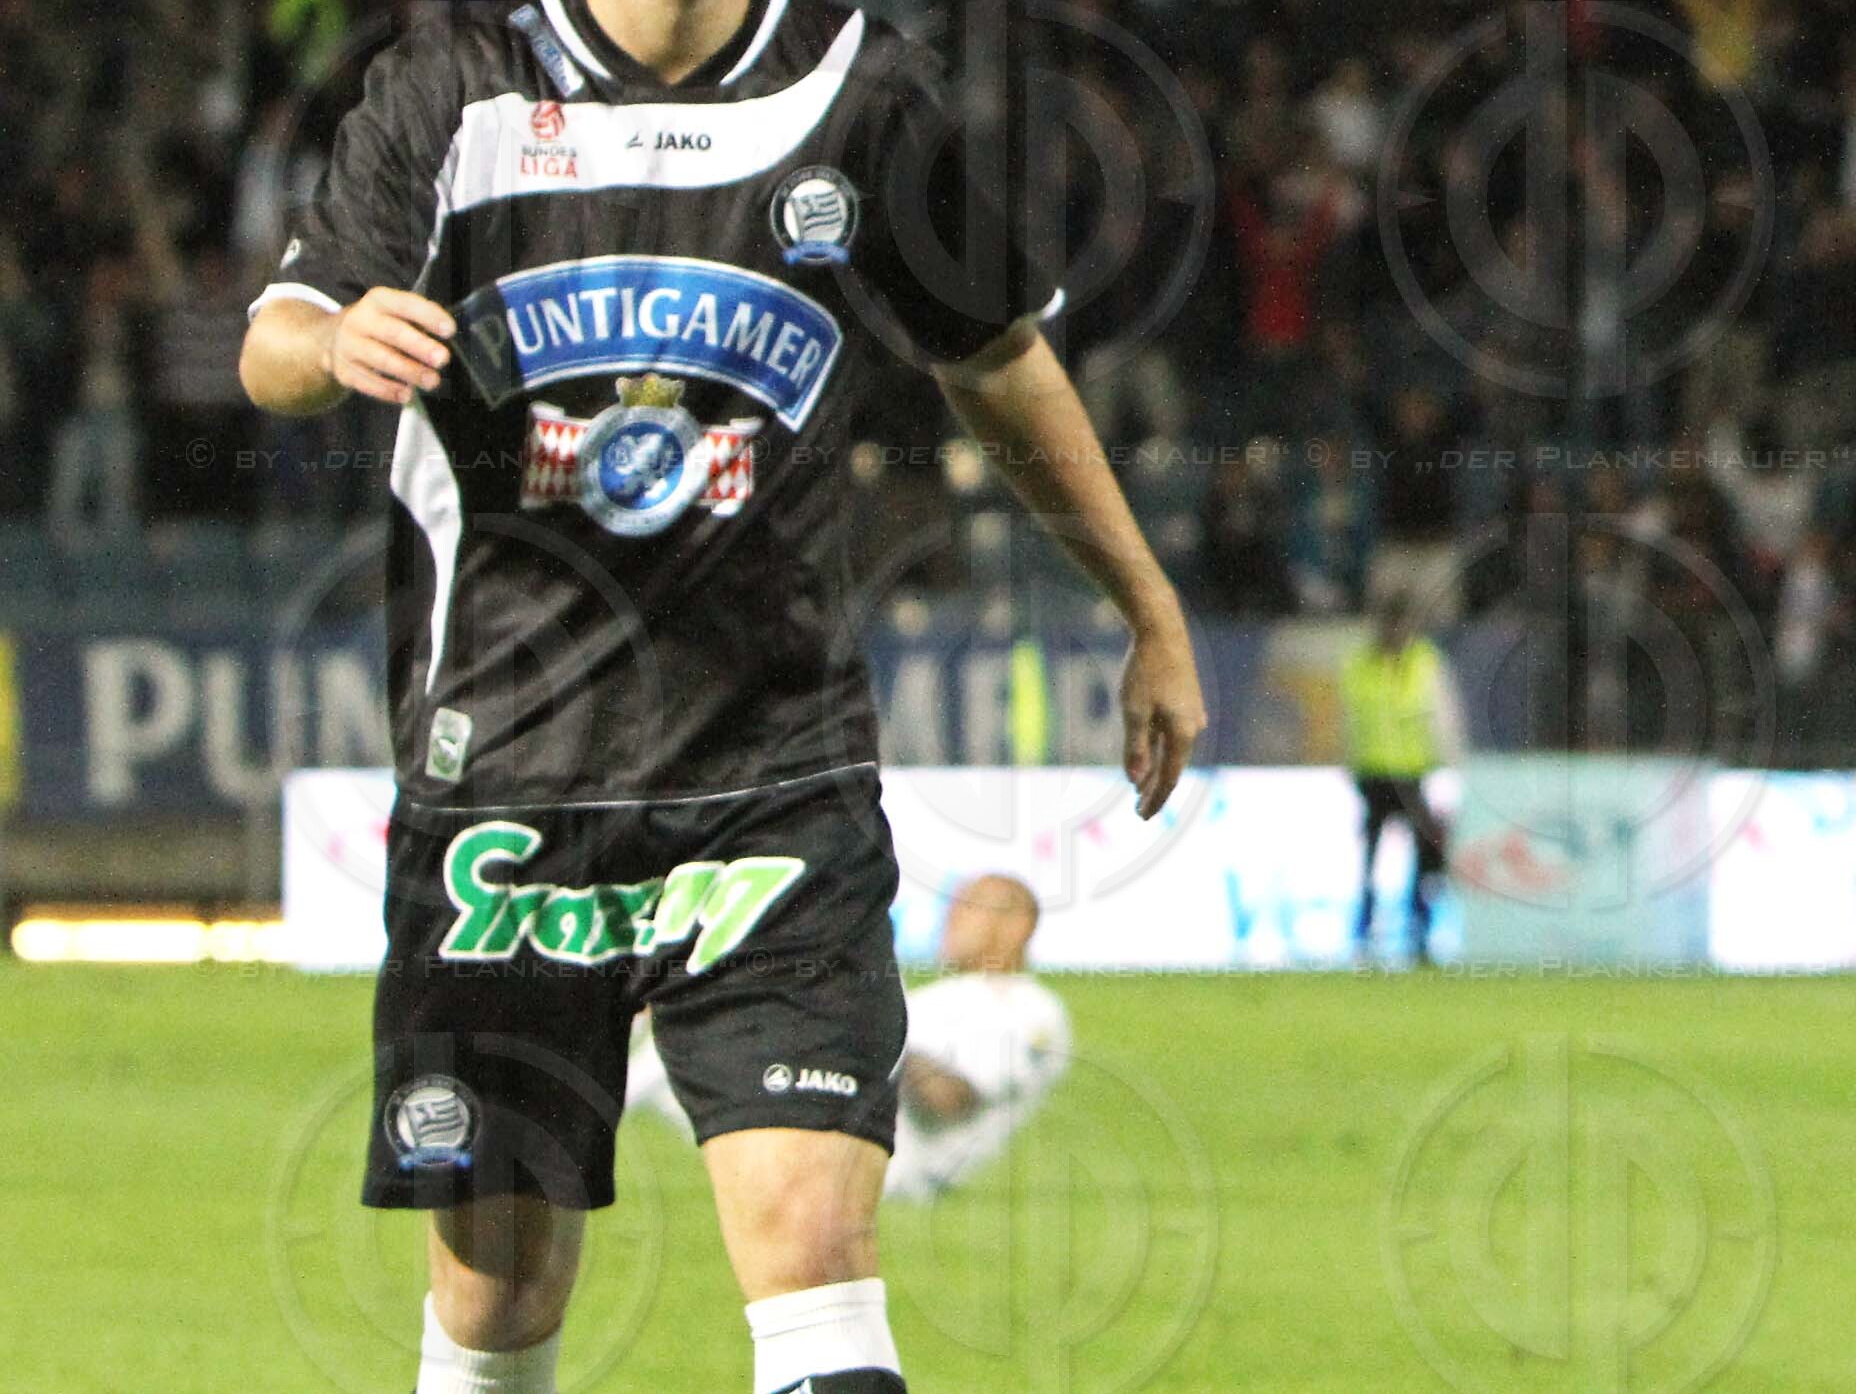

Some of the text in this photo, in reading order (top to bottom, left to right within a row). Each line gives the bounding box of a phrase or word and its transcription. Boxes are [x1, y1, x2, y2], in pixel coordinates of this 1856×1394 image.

[654, 132, 712, 151] JAKO
[520, 157, 577, 177] LIGA
[469, 286, 823, 391] PUNTIGAMER
[795, 1068, 859, 1096] JAKO
